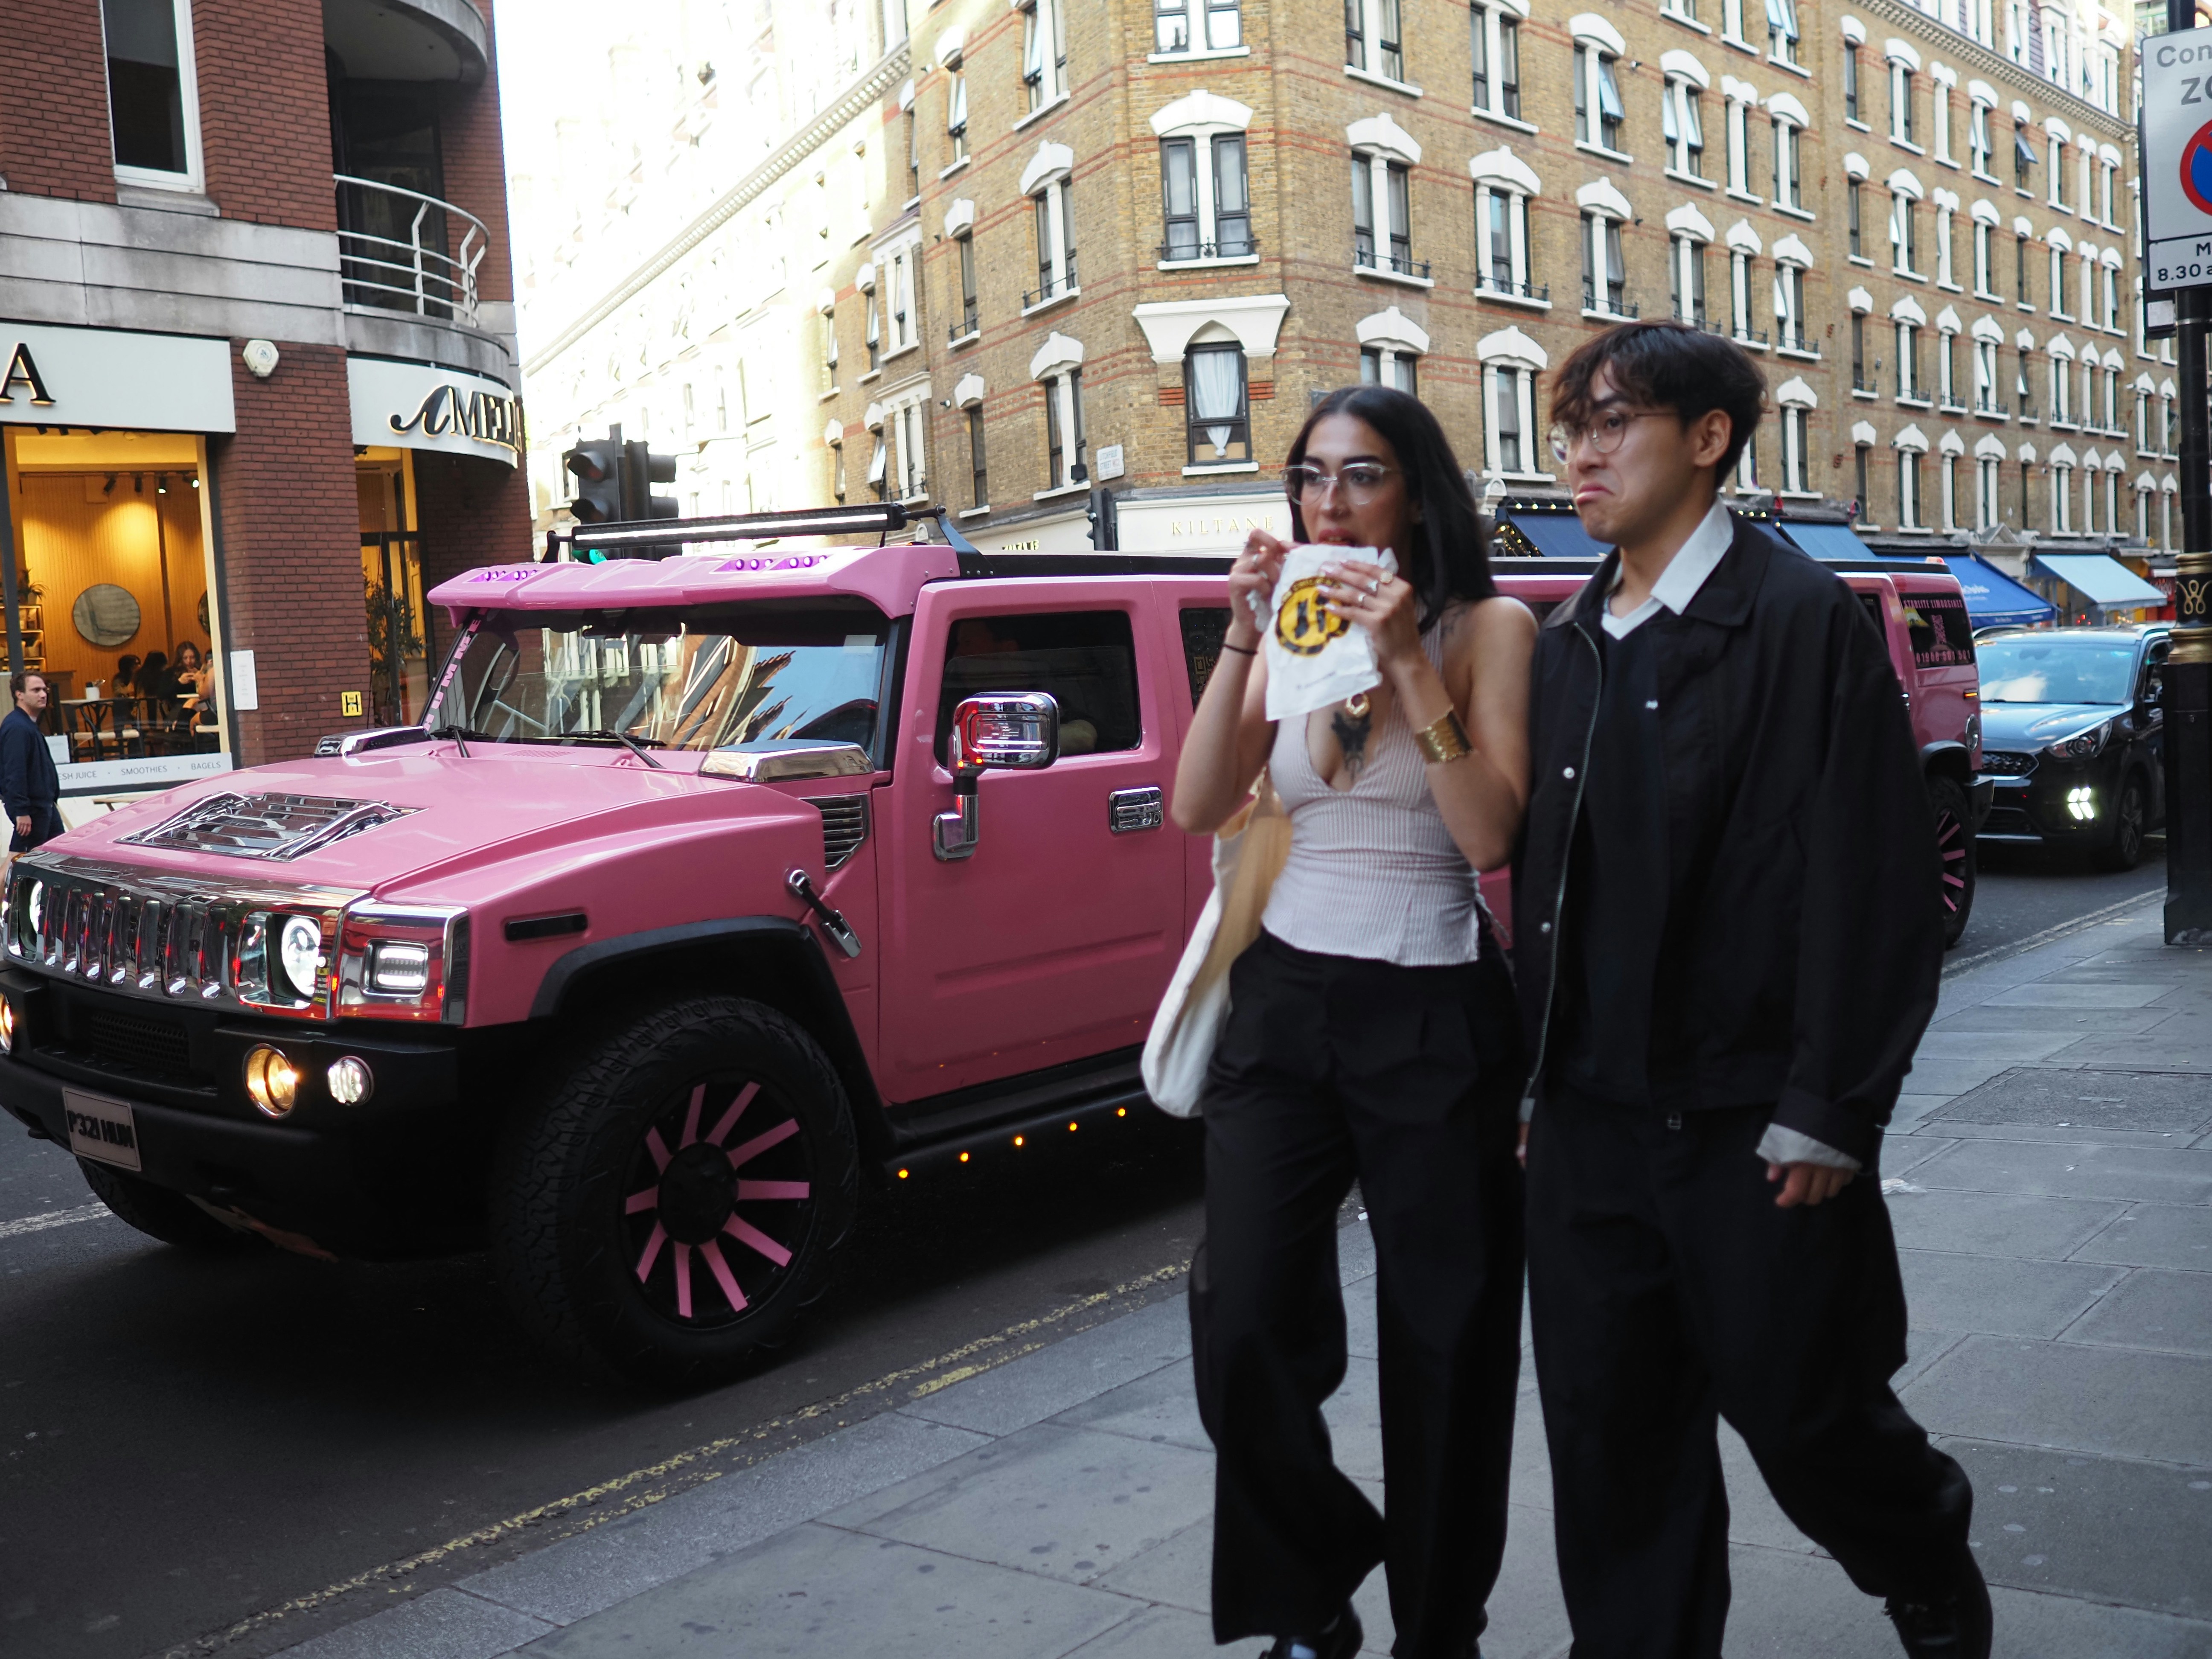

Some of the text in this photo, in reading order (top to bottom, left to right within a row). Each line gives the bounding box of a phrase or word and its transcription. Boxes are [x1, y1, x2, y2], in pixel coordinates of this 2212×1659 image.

[2158, 264, 2201, 281] 8.30
[1172, 516, 1273, 534] KILTANE
[1930, 600, 1963, 608] LIMOUSINES
[58, 761, 221, 781] ESH JUICE SMOOTHIES BAGELS
